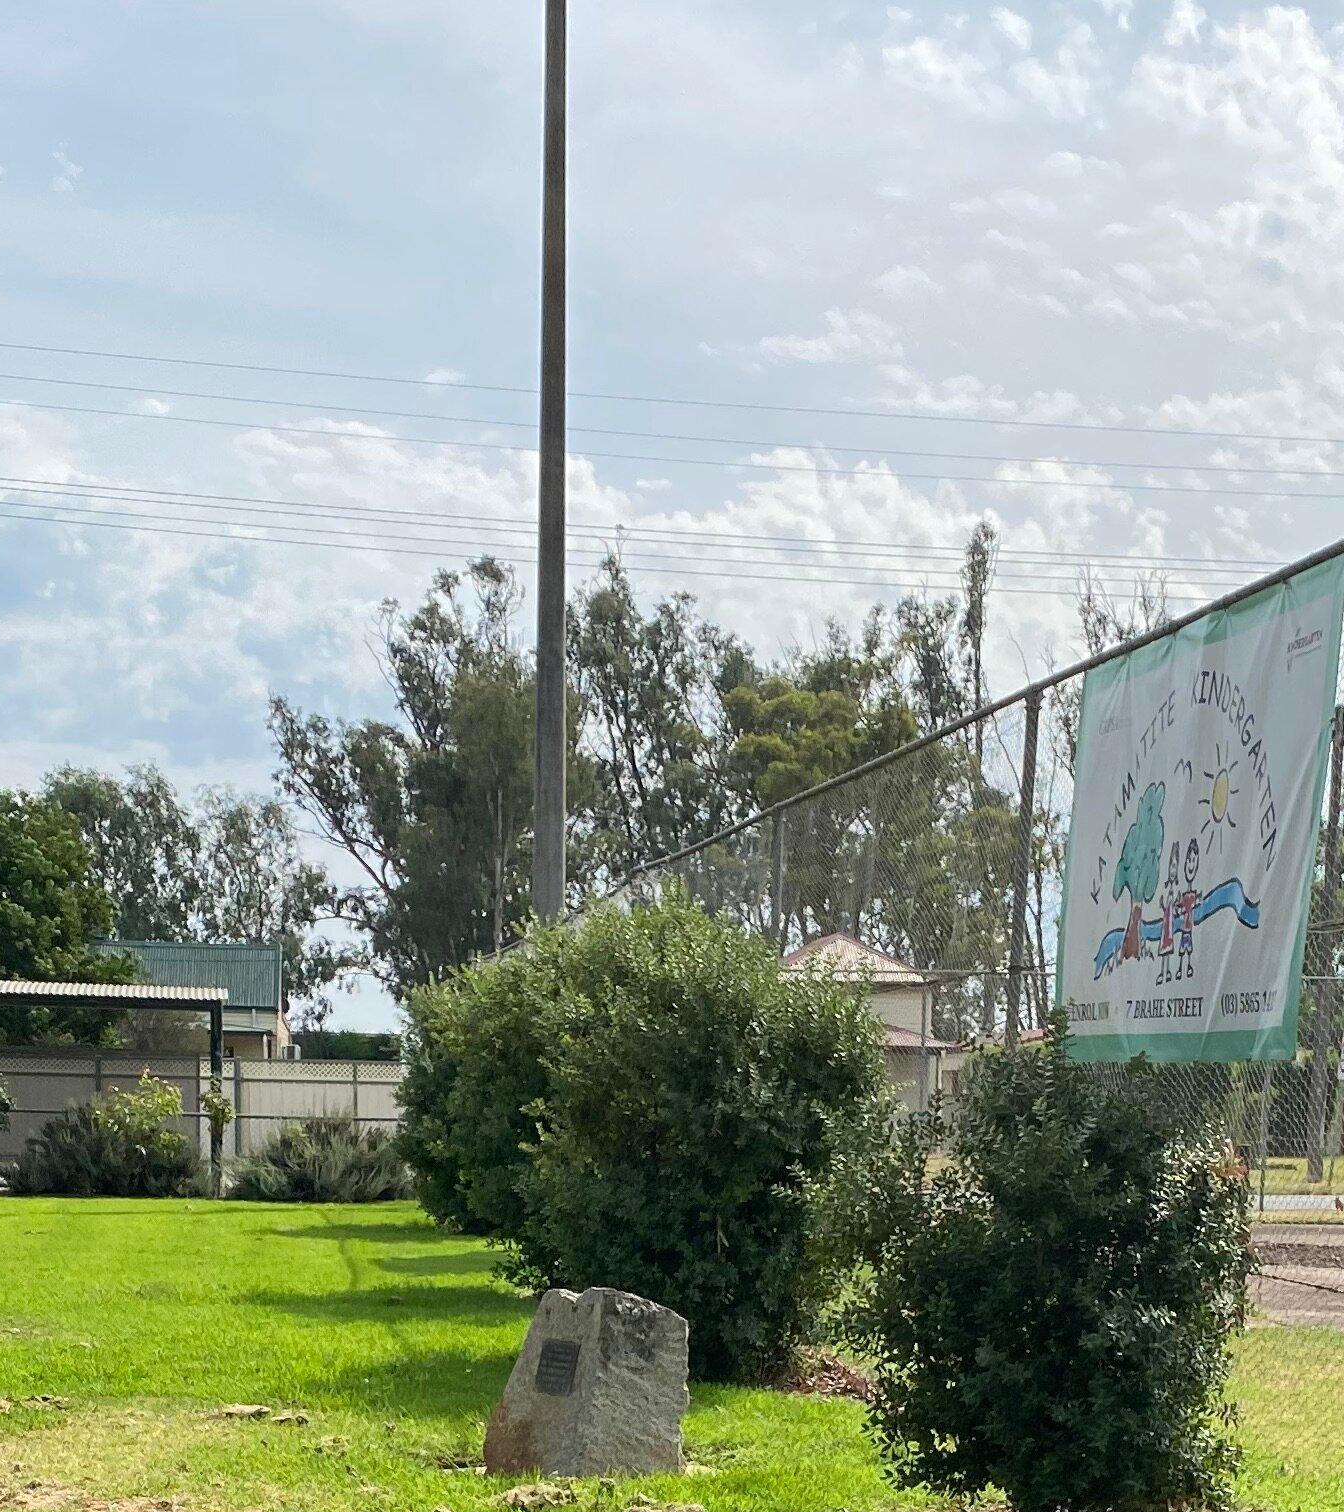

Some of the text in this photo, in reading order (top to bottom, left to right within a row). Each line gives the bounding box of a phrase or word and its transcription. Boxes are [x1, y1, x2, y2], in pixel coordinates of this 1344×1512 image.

[1191, 670, 1277, 872] KINDERGARTEN
[1126, 1000, 1132, 1019] 7
[1133, 999, 1165, 1019] BRAHE
[1166, 997, 1204, 1018] STREET
[1221, 992, 1239, 1018] (03)
